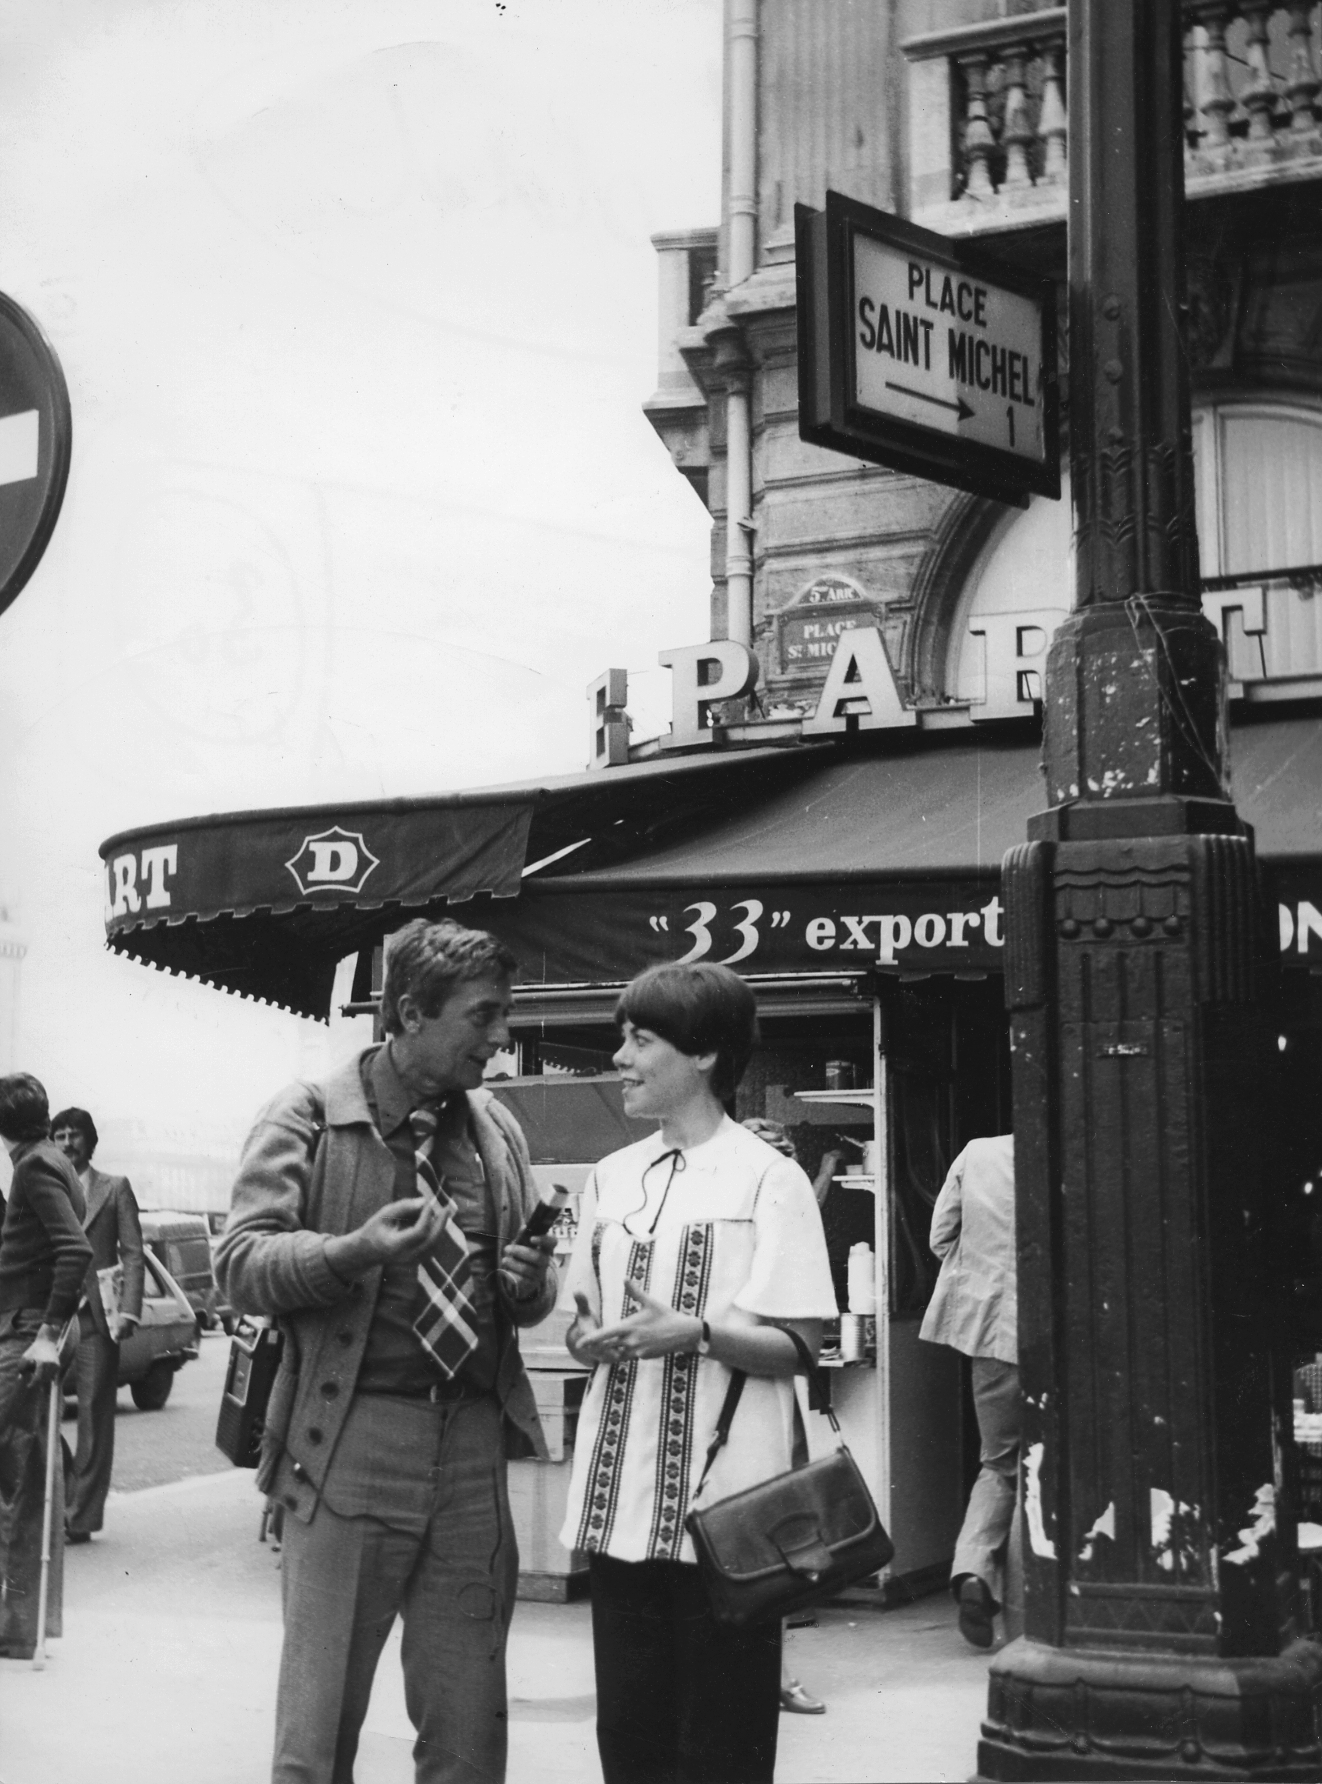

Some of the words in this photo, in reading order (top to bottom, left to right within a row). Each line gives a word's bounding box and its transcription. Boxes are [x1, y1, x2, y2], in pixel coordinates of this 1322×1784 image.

[908, 261, 987, 328] PLACE
[858, 296, 934, 371] SAINT
[949, 328, 1035, 406] MICHEL
[1006, 405, 1016, 447] 1
[807, 641, 837, 658] MIC
[104, 844, 177, 923] RT
[307, 841, 358, 881] D
[805, 896, 1005, 965] export
